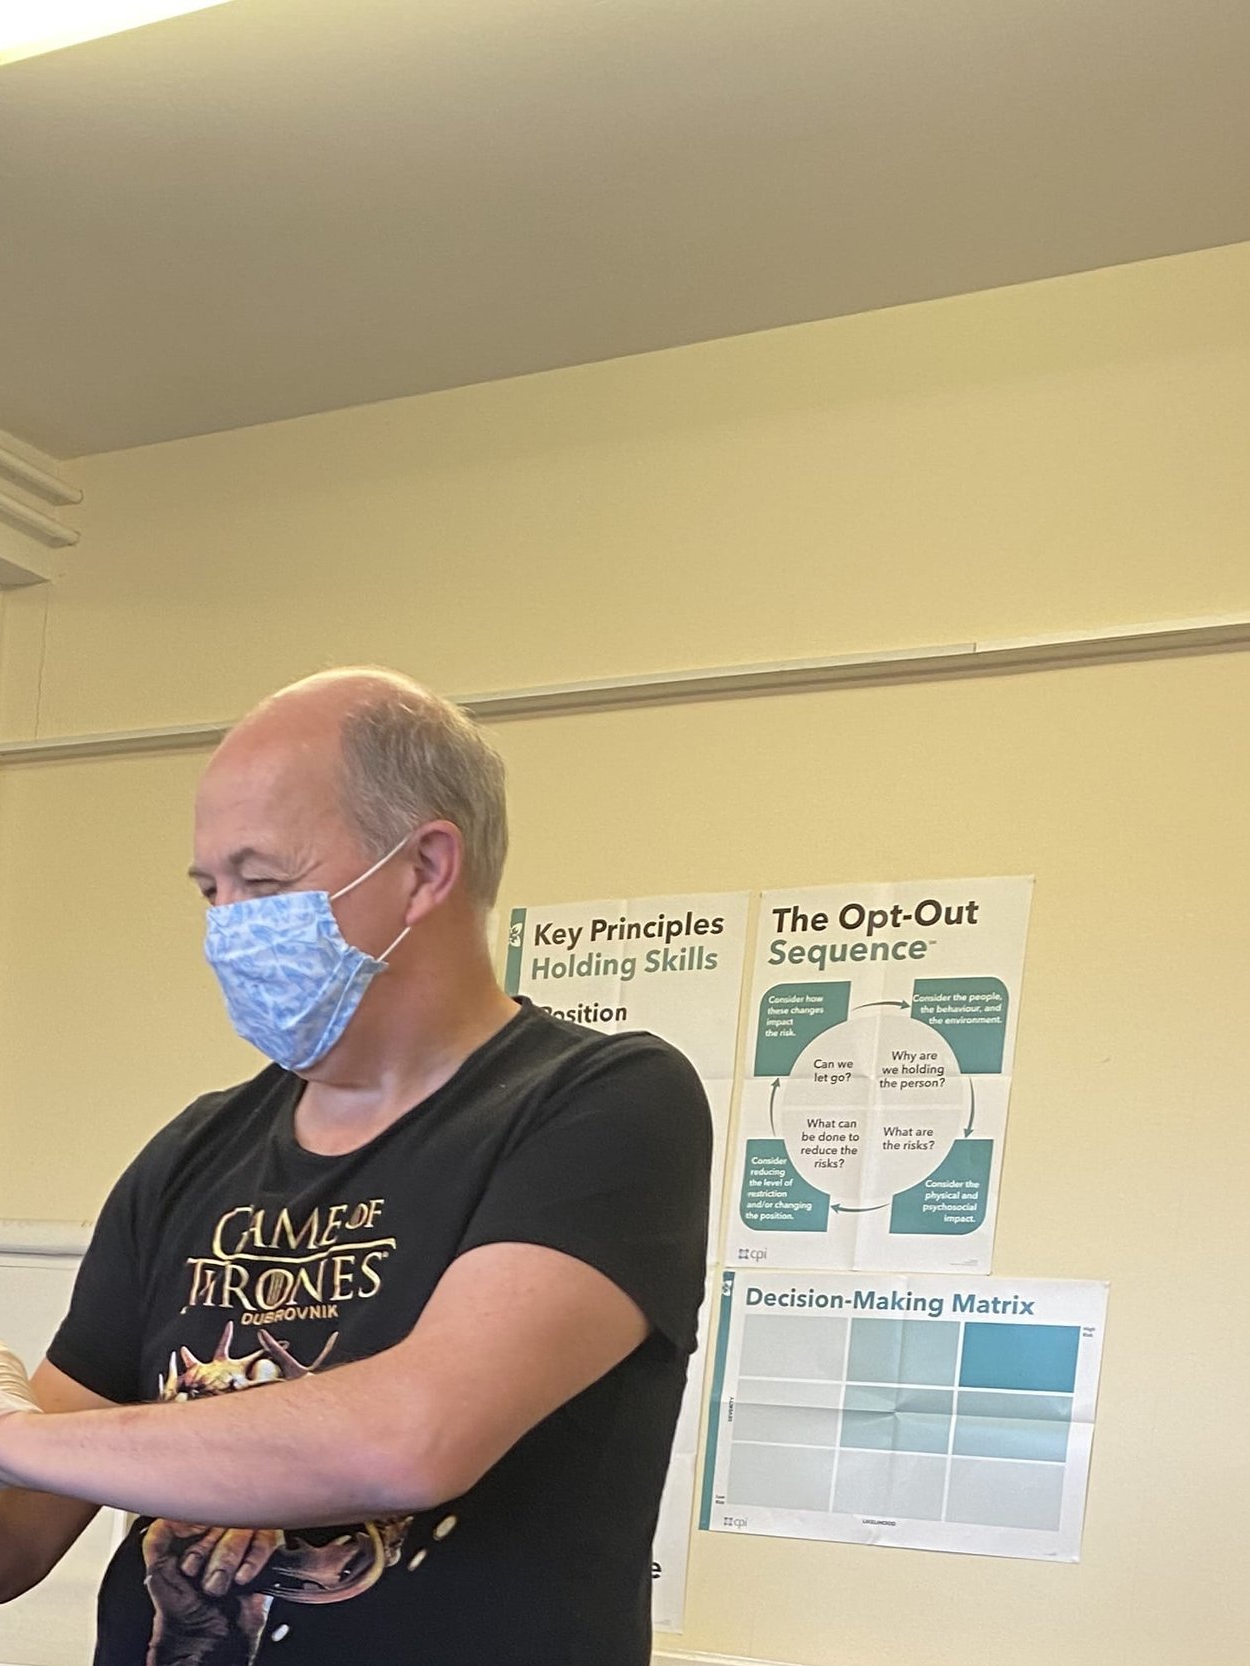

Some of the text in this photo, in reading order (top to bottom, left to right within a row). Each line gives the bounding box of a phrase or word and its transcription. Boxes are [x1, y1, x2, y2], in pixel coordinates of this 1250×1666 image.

[772, 899, 980, 937] The Opt-Out
[534, 911, 725, 951] Key Principles
[531, 945, 718, 982] Holding Skills
[768, 994, 823, 1004] Consider how
[913, 994, 951, 1003] Consider
[953, 993, 967, 1002] the
[767, 1006, 824, 1016] these changes
[920, 1005, 934, 1014] the
[984, 1003, 1002, 1012] and
[766, 1018, 794, 1027] impact
[929, 1016, 943, 1025] the
[765, 1028, 796, 1037] the risk.
[891, 1051, 938, 1063] Why are
[813, 1059, 854, 1070] Can we
[882, 1065, 945, 1078] we holding
[814, 1072, 852, 1085] let go?
[879, 1077, 946, 1091] the person?
[807, 1119, 857, 1129] What can
[802, 1132, 860, 1142] be done to
[883, 1127, 934, 1137] What are
[800, 1145, 858, 1155] reduce the
[882, 1140, 935, 1150] the risks?
[751, 1156, 787, 1165] Consider
[814, 1158, 845, 1169] risks?
[750, 1167, 786, 1178] reducing
[749, 1178, 793, 1187] the level of
[925, 1179, 980, 1189] Consider the
[747, 1189, 787, 1198] restriction
[925, 1191, 979, 1202] physical and
[746, 1200, 812, 1211] and/or changing
[922, 1202, 977, 1213] psychosocial
[745, 1211, 794, 1222] the position.
[943, 1214, 976, 1224] impact.
[212, 1198, 385, 1258] GAME OF
[745, 1286, 1035, 1318] Decision-Making Matrix
[241, 1304, 339, 1326] DUBROVNIK
